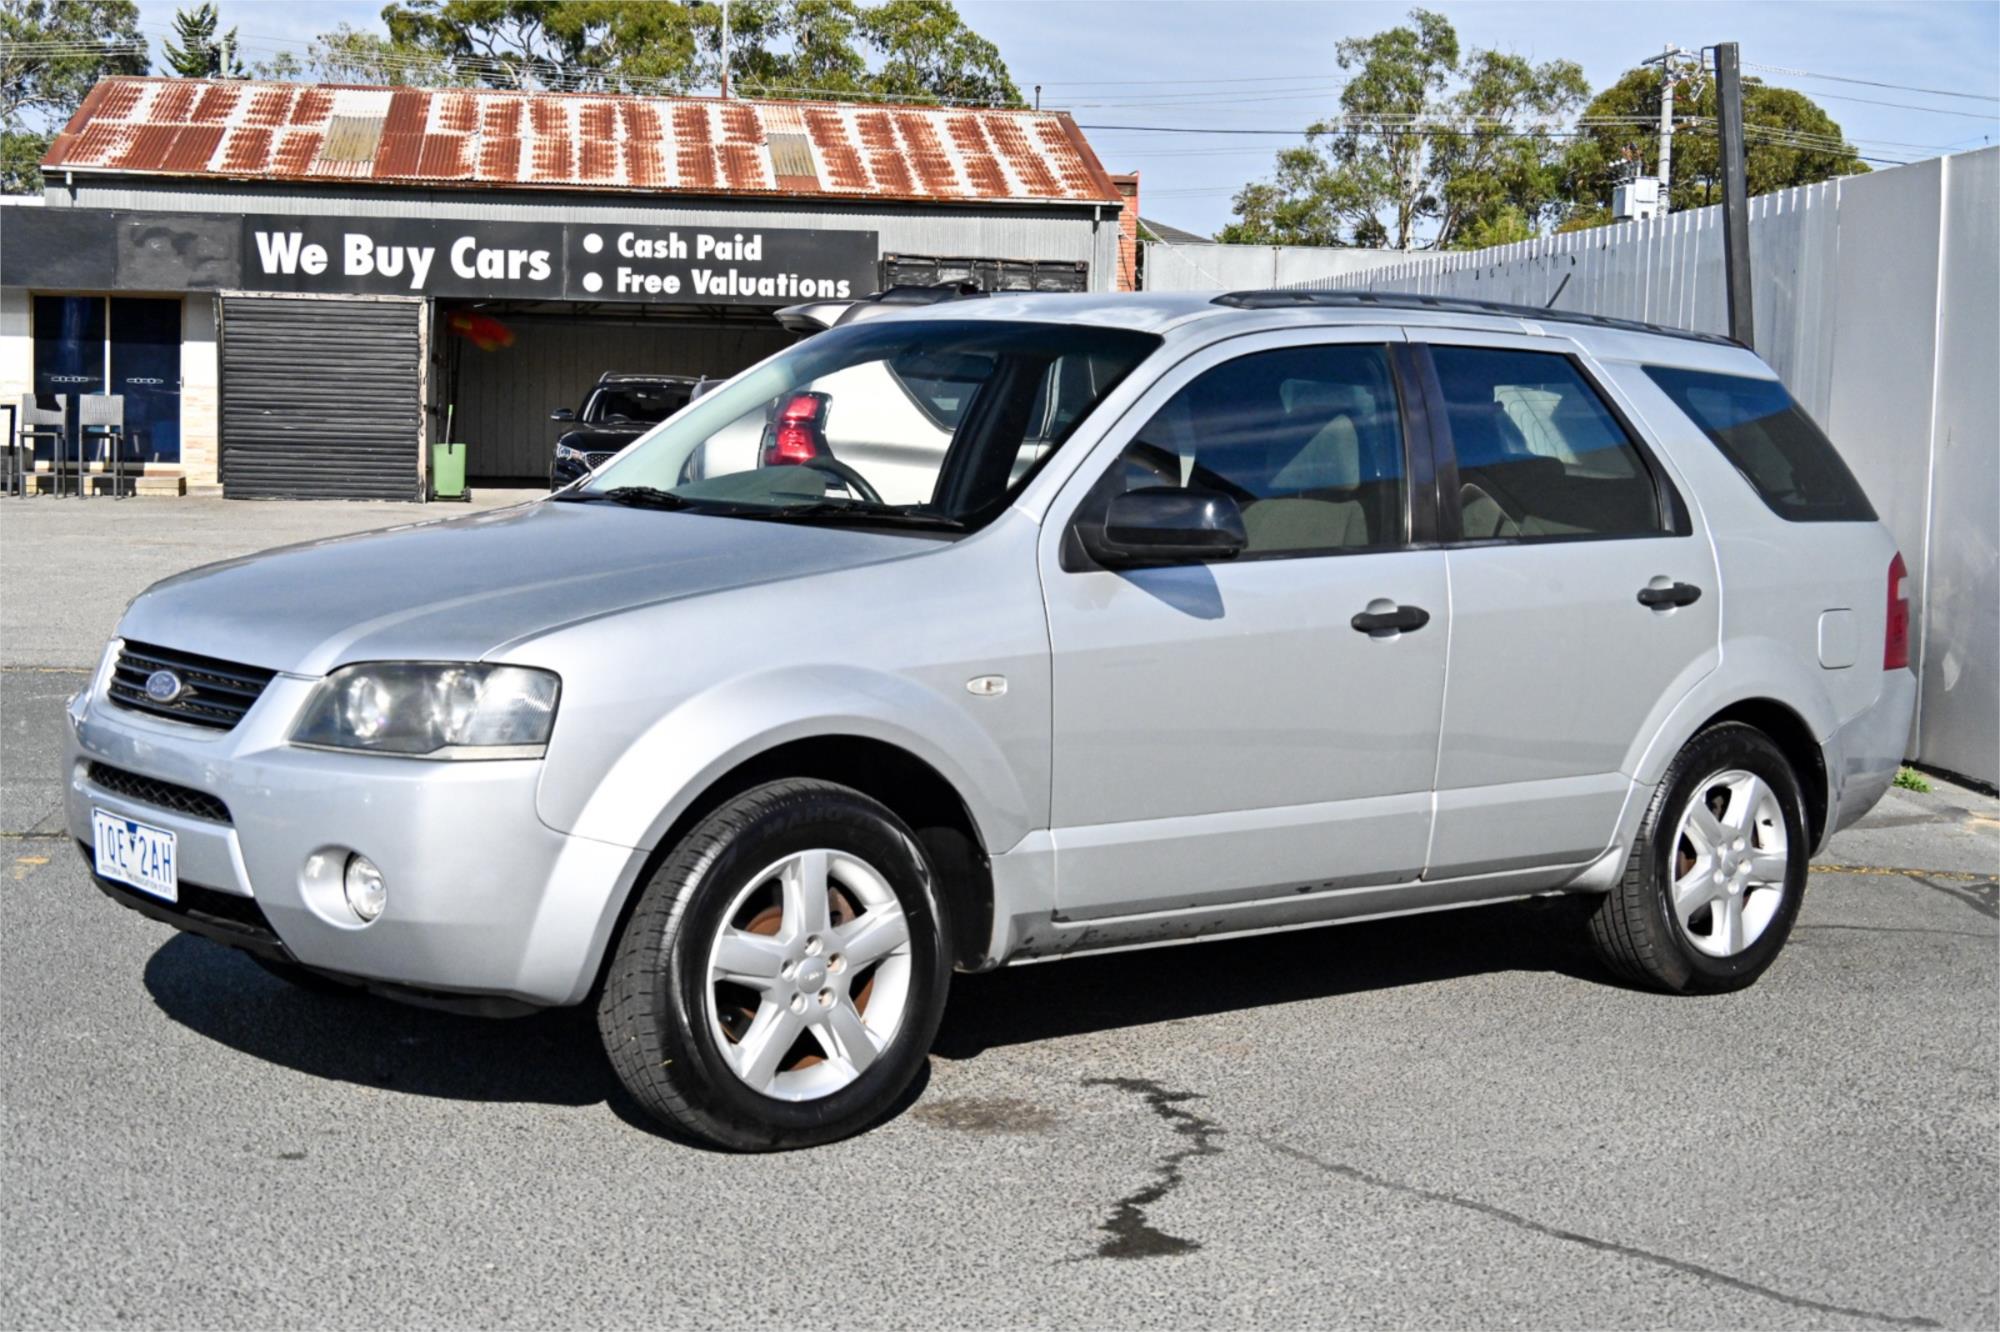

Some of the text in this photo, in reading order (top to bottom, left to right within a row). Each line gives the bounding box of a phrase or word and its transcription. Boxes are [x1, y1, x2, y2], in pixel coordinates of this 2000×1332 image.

[254, 231, 552, 290] We Buy Cars
[617, 231, 762, 262] Cash Paid
[617, 266, 851, 299] Free Valuations
[138, 836, 172, 884] 2AH
